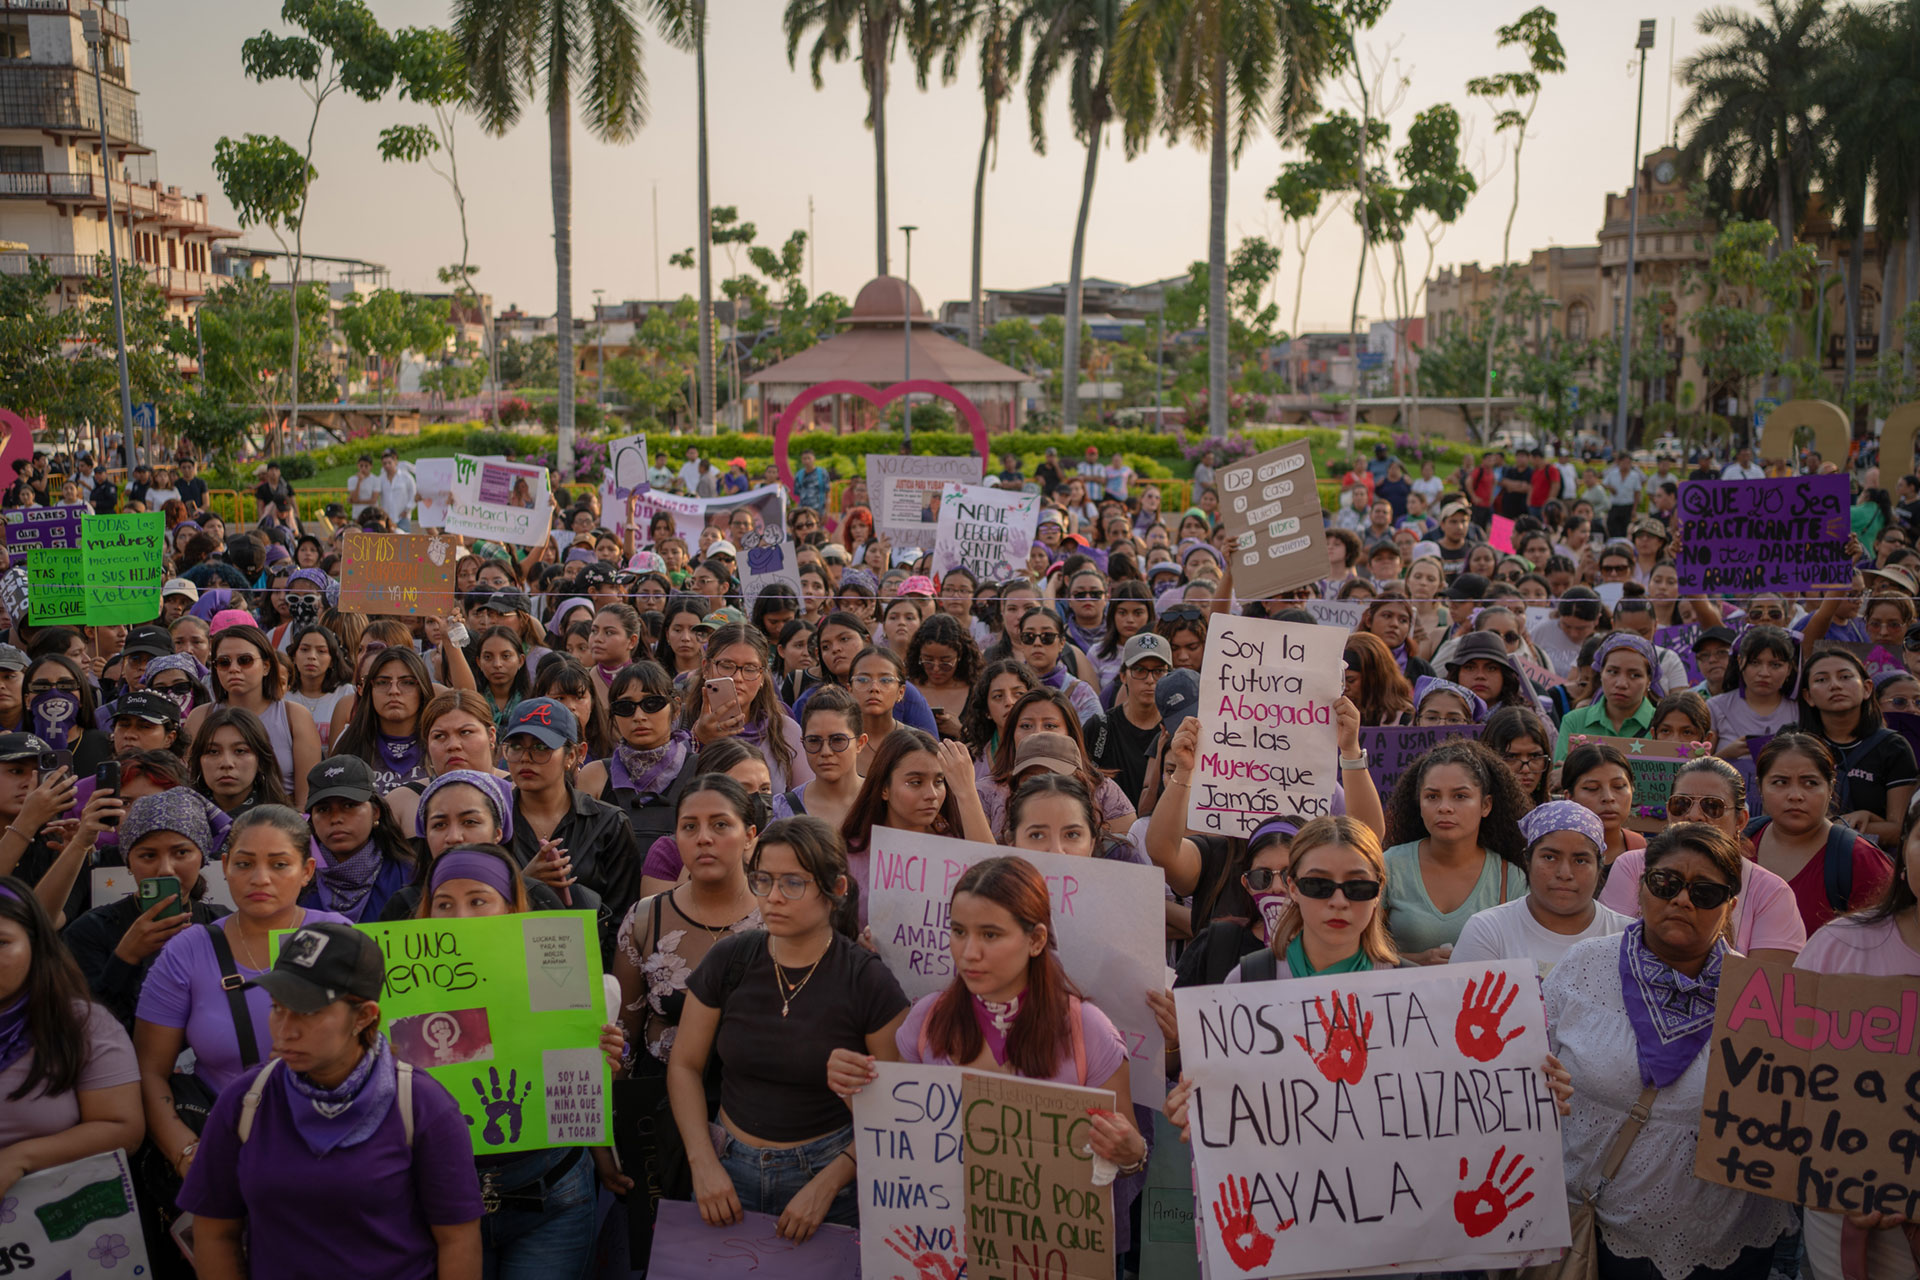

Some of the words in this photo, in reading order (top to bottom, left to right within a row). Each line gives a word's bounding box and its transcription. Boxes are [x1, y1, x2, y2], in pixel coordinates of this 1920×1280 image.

[1227, 470, 1251, 490] De
[1259, 455, 1302, 480] camino
[1264, 481, 1291, 498] casa
[1682, 484, 1740, 518] QUE
[28, 510, 66, 522] SABES
[85, 517, 131, 533] TODAS
[957, 502, 1010, 525] NADIE
[18, 529, 39, 540] QUE
[51, 525, 64, 536] ES
[1269, 519, 1297, 537] libre
[1683, 517, 1823, 542] PRACTICANTE
[9, 542, 43, 554] MIEDO
[86, 533, 159, 551] madres
[352, 535, 395, 563] SOMOS
[959, 541, 1008, 561] SENTIR
[1682, 544, 1712, 565] NO
[89, 555, 140, 567] merecen
[32, 568, 55, 580] TAS
[62, 571, 79, 585] por
[102, 569, 126, 584] SUS
[129, 566, 161, 582] HIJAS
[1702, 565, 1767, 591] ABUSAR
[388, 585, 401, 601] YA
[404, 586, 419, 602] NO
[30, 602, 57, 616] LAS
[59, 600, 85, 617] QUE
[1312, 605, 1359, 627] SOMOS
[1220, 631, 1264, 666] Soy
[1282, 634, 1306, 663] la
[1219, 663, 1303, 695] futura
[519, 703, 553, 726] A
[1218, 694, 1331, 729] Abogada
[1213, 721, 1247, 748] de
[1253, 725, 1291, 751] las
[1397, 730, 1437, 750] USAR
[1364, 752, 1385, 769] UE
[1269, 766, 1316, 792] que
[1649, 783, 1667, 793] NO
[1197, 783, 1279, 812] Jamás
[1206, 812, 1222, 830] a
[873, 849, 927, 893] NACI
[1726, 966, 1920, 1057] Abuel
[1199, 1003, 1285, 1059] NOS
[1301, 991, 1439, 1054] FALTA
[558, 1070, 575, 1083] SOY
[579, 1070, 590, 1082] LA
[1720, 1036, 1840, 1103] Vine
[1853, 1069, 1888, 1104] a
[546, 1082, 573, 1098] MAMÁ
[577, 1083, 588, 1095] DE
[591, 1084, 602, 1096] LA
[555, 1095, 576, 1111] NIÑA
[580, 1098, 596, 1110] QUE
[892, 1080, 963, 1131] SOY
[1194, 1077, 1365, 1149] LAURA
[1374, 1066, 1560, 1143] ELIZABETH
[551, 1111, 581, 1125] NUNCA
[585, 1111, 601, 1124] VAS
[965, 1099, 1094, 1161] GRITO
[1703, 1089, 1814, 1156] todo
[1820, 1108, 1869, 1155] lo
[558, 1126, 565, 1138] A
[568, 1126, 597, 1138] TOCAR
[864, 1127, 915, 1161] TIA
[1716, 1146, 1776, 1189] te
[873, 1176, 951, 1210] NIÑAS
[970, 1164, 1042, 1211] PELEO
[1053, 1183, 1105, 1225] POR
[1245, 1161, 1423, 1232] AYALA
[915, 1225, 951, 1251] NO
[1056, 1221, 1105, 1254] QUE
[972, 1235, 1001, 1270] YA
[1012, 1243, 1068, 1280] NO
